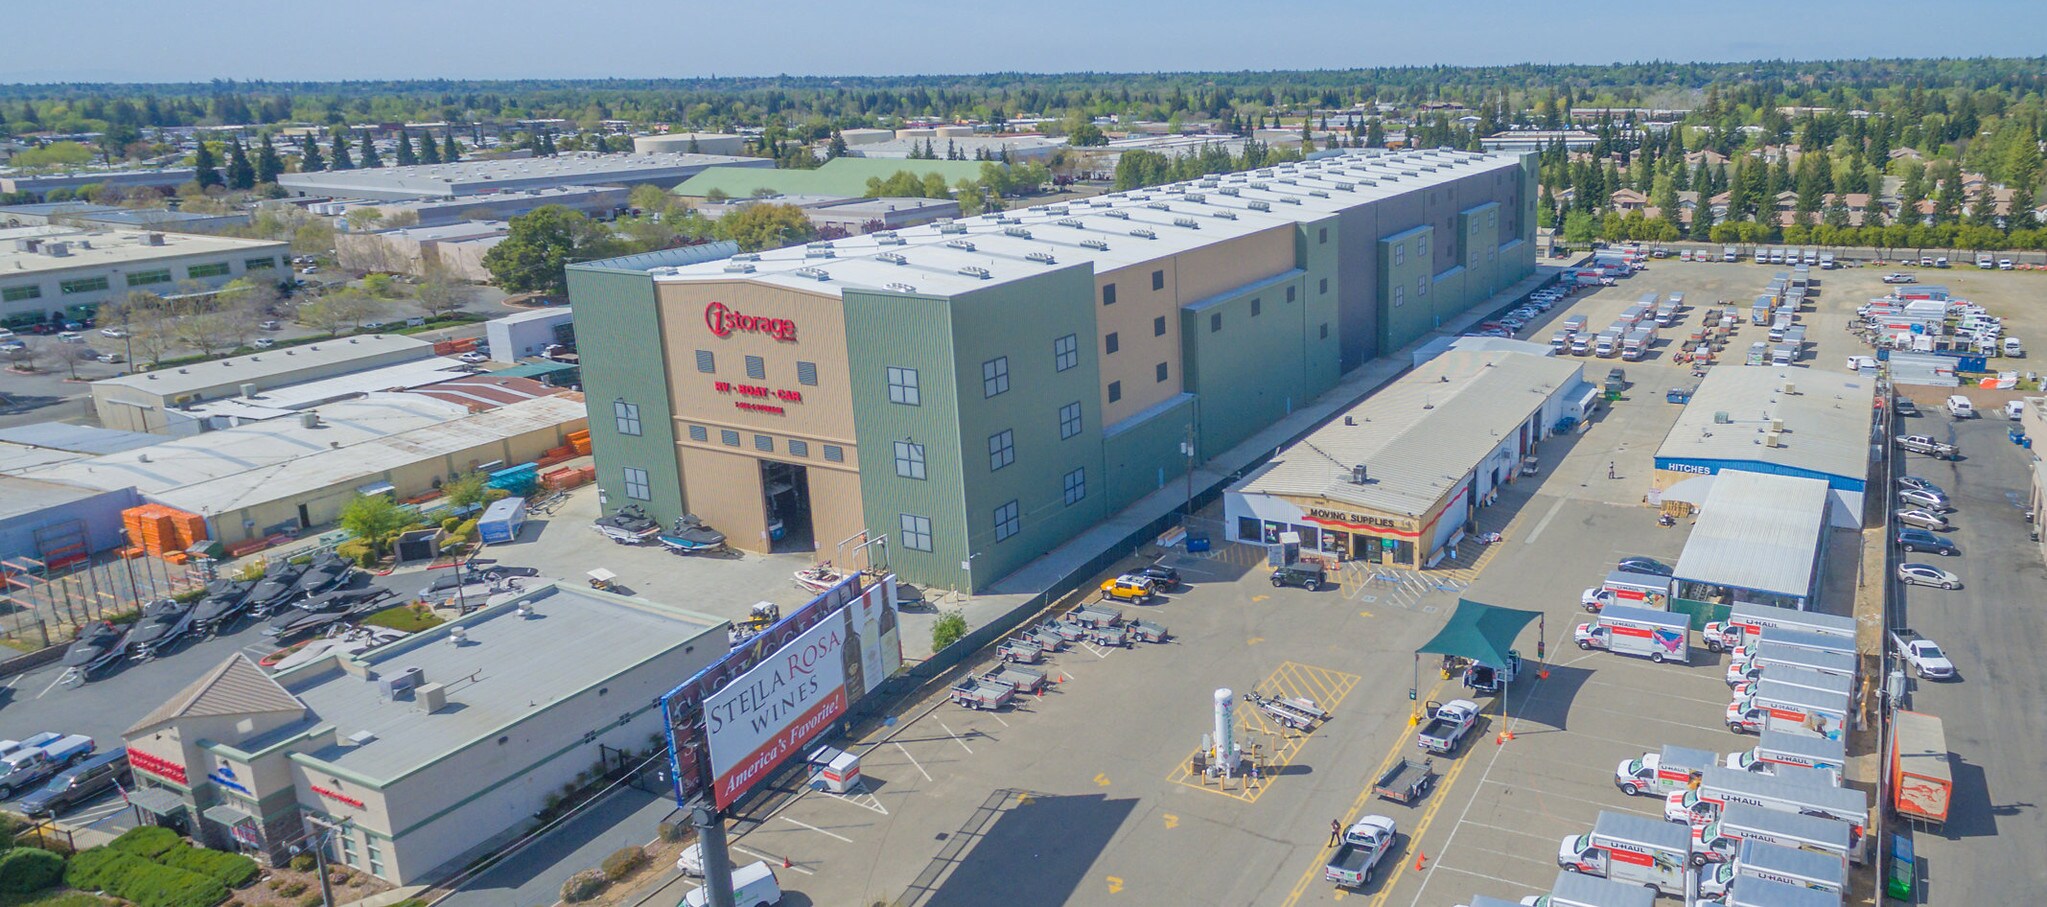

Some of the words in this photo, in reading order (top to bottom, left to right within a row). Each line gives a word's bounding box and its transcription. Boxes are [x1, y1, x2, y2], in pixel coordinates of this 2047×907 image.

[777, 390, 801, 401] CAR
[1668, 463, 1710, 474] HITCHES
[1311, 509, 1345, 520] MOVING
[1351, 514, 1394, 527] SUPPLIES
[711, 670, 785, 734] STELLA
[787, 631, 840, 680] ROSA
[752, 675, 818, 734] WINES
[725, 739, 786, 797] America's
[790, 694, 839, 746] Favorite!
[1721, 794, 1764, 807] U-HAUL
[1741, 832, 1776, 843] U-HAUL
[1611, 842, 1645, 853] U-HAUL
[1758, 873, 1796, 885] U-HAUL
